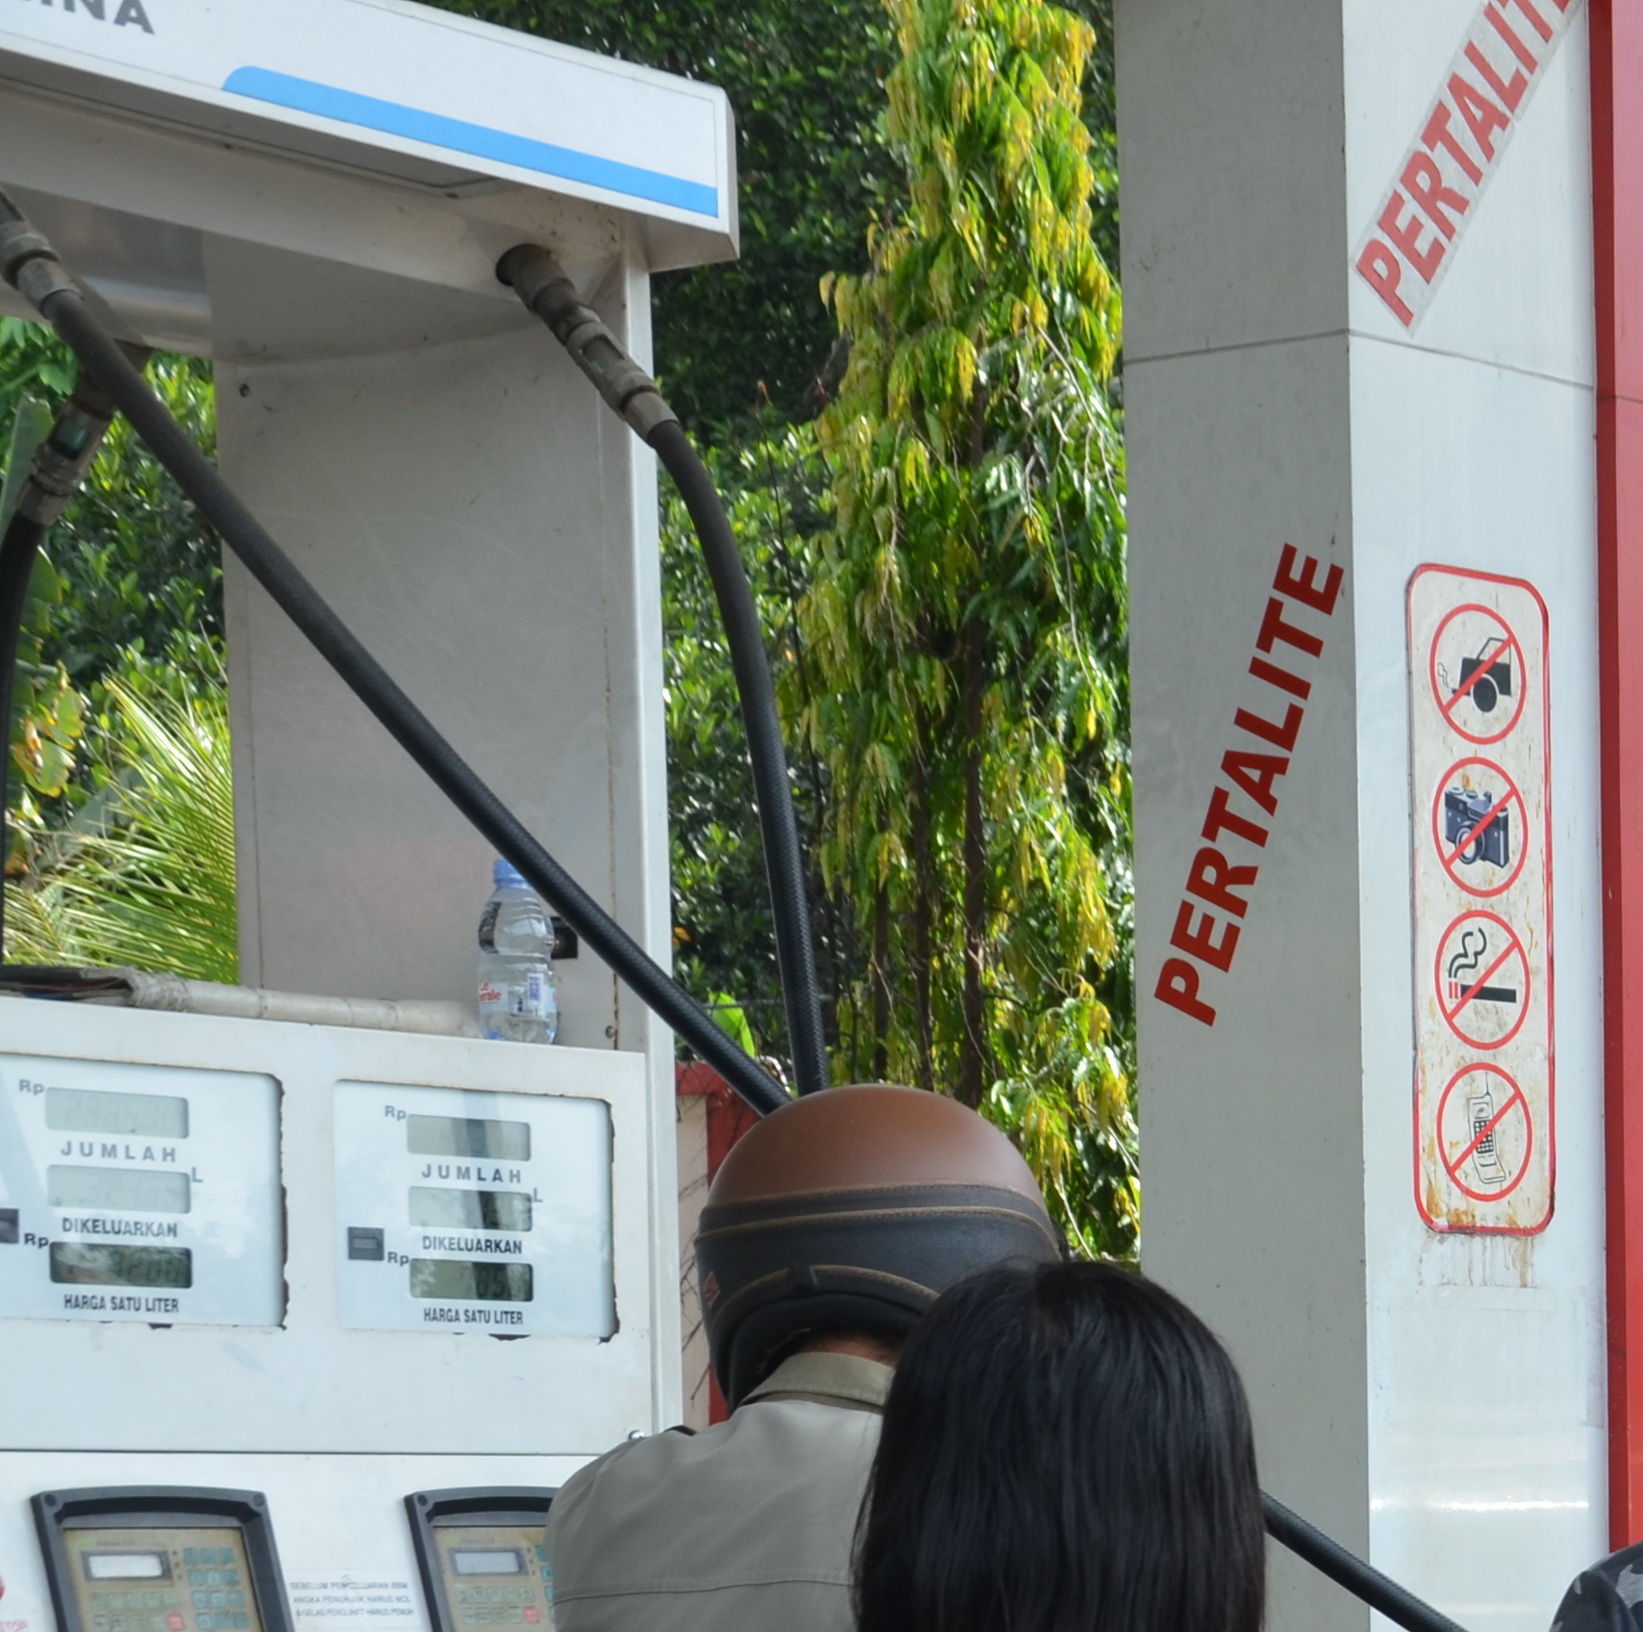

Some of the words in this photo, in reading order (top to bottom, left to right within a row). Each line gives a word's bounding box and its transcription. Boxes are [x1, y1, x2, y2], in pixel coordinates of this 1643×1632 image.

[1356, 0, 1570, 327] PERTALIT
[1154, 543, 1344, 1026] PERTALITE
[19, 1079, 44, 1096] Rp
[384, 1105, 407, 1121] Rp
[61, 1141, 176, 1163] JUMLAH
[422, 1164, 521, 1183] JUMLAH
[62, 1218, 178, 1238] DIKELUARKAN
[24, 1233, 49, 1249] Rp
[422, 1236, 522, 1254] DIKELUARKAN
[388, 1251, 409, 1266] Rp
[64, 1294, 106, 1311] HARGA
[111, 1296, 141, 1312] SATU
[145, 1297, 179, 1313] LITER
[424, 1308, 460, 1323] HARGA
[464, 1309, 491, 1324] SATU
[494, 1310, 523, 1325] LITER
